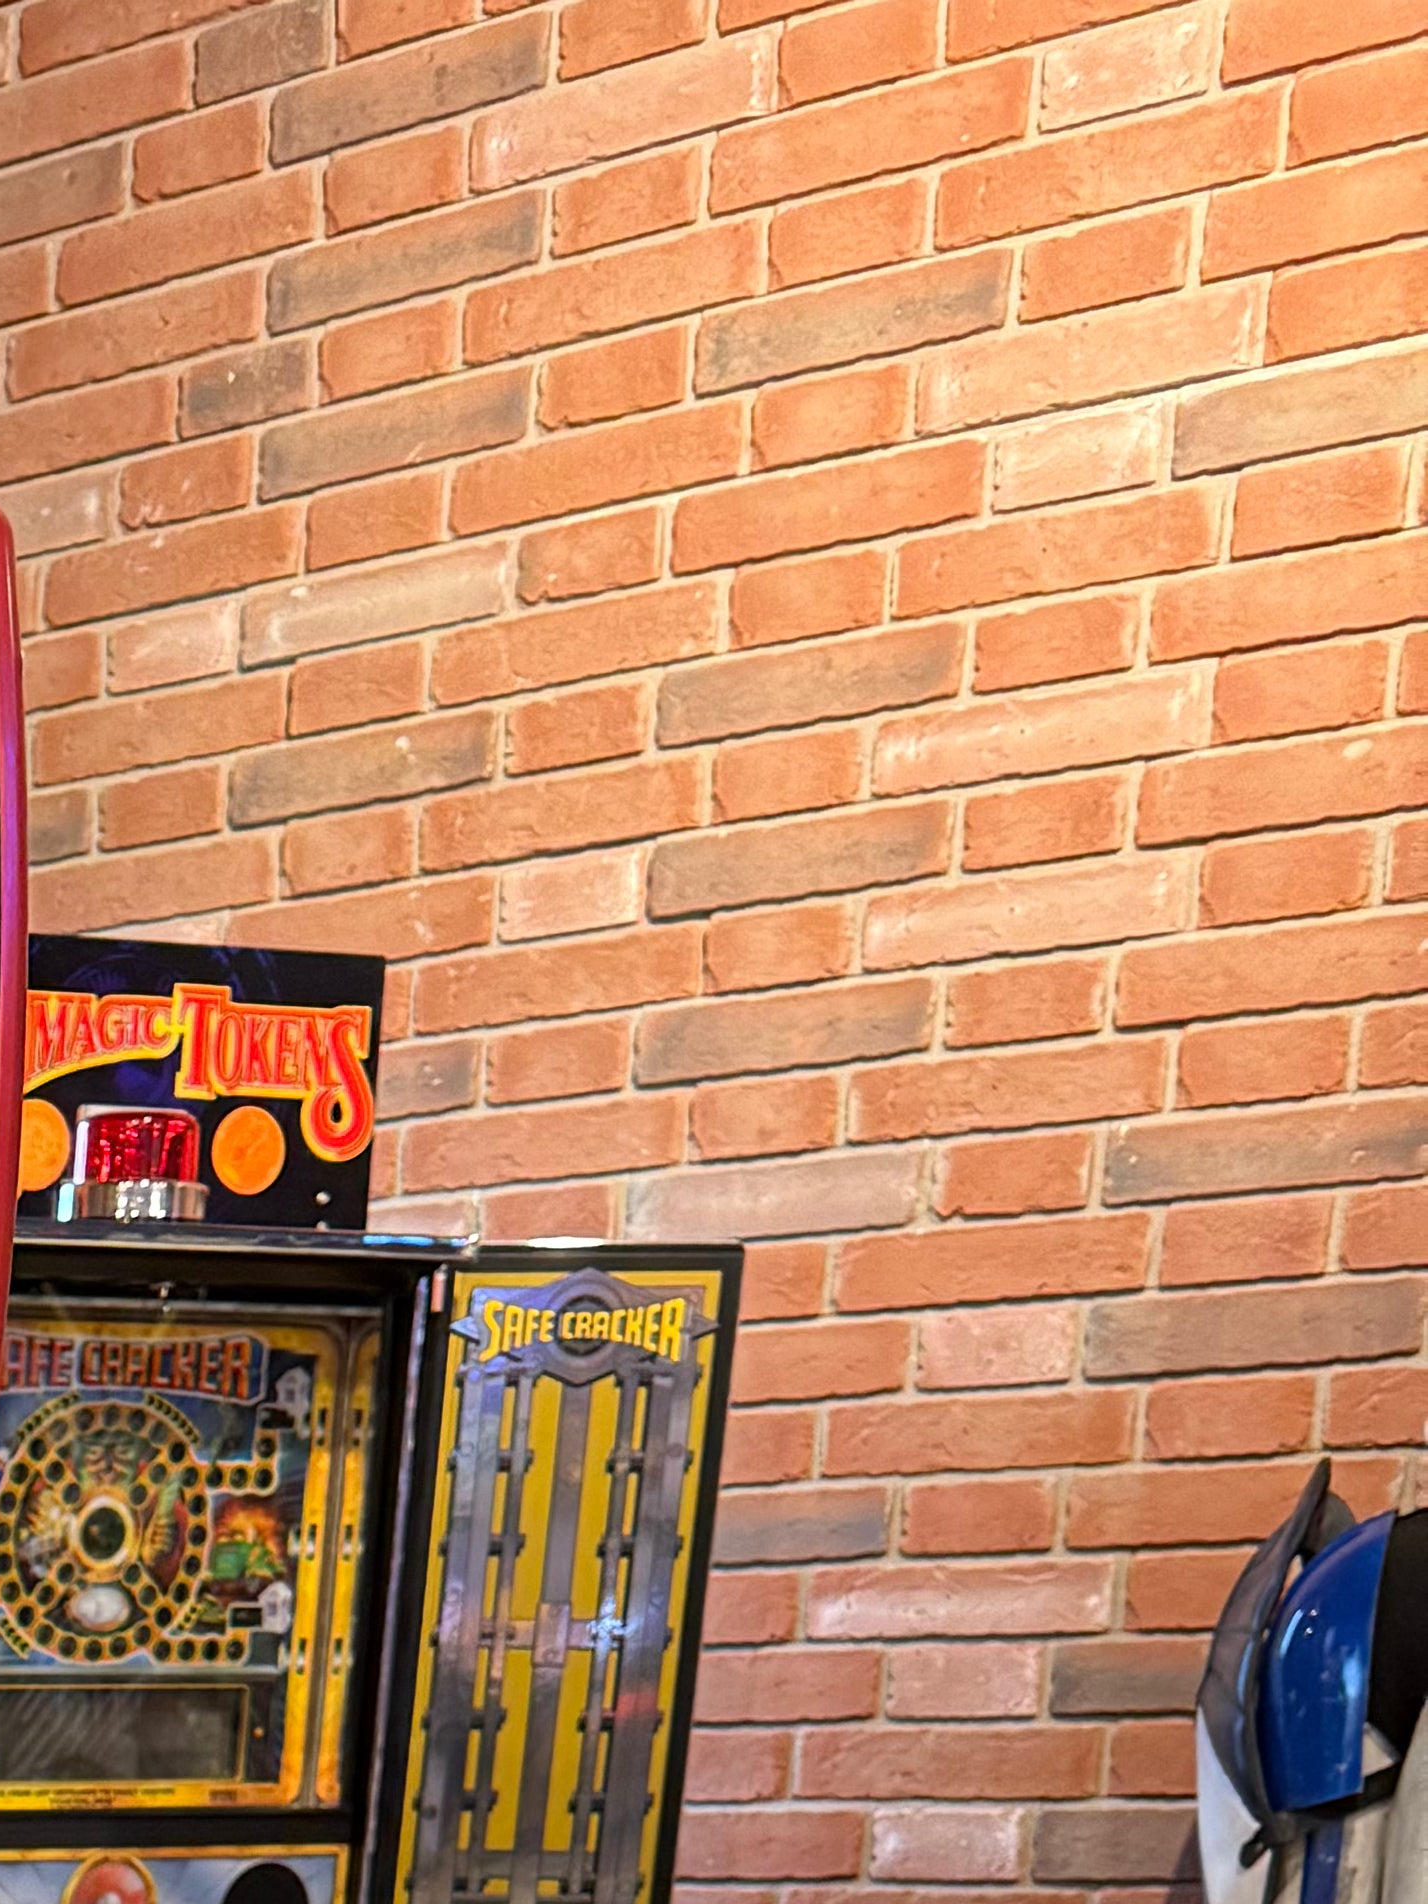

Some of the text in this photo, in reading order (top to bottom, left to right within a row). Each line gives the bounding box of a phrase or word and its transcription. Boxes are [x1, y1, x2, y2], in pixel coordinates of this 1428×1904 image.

[26, 984, 374, 1159] MAGIC TOKENS
[478, 1297, 686, 1363] SAFE CRACKER
[1, 1334, 252, 1400] AFE CRACKER
